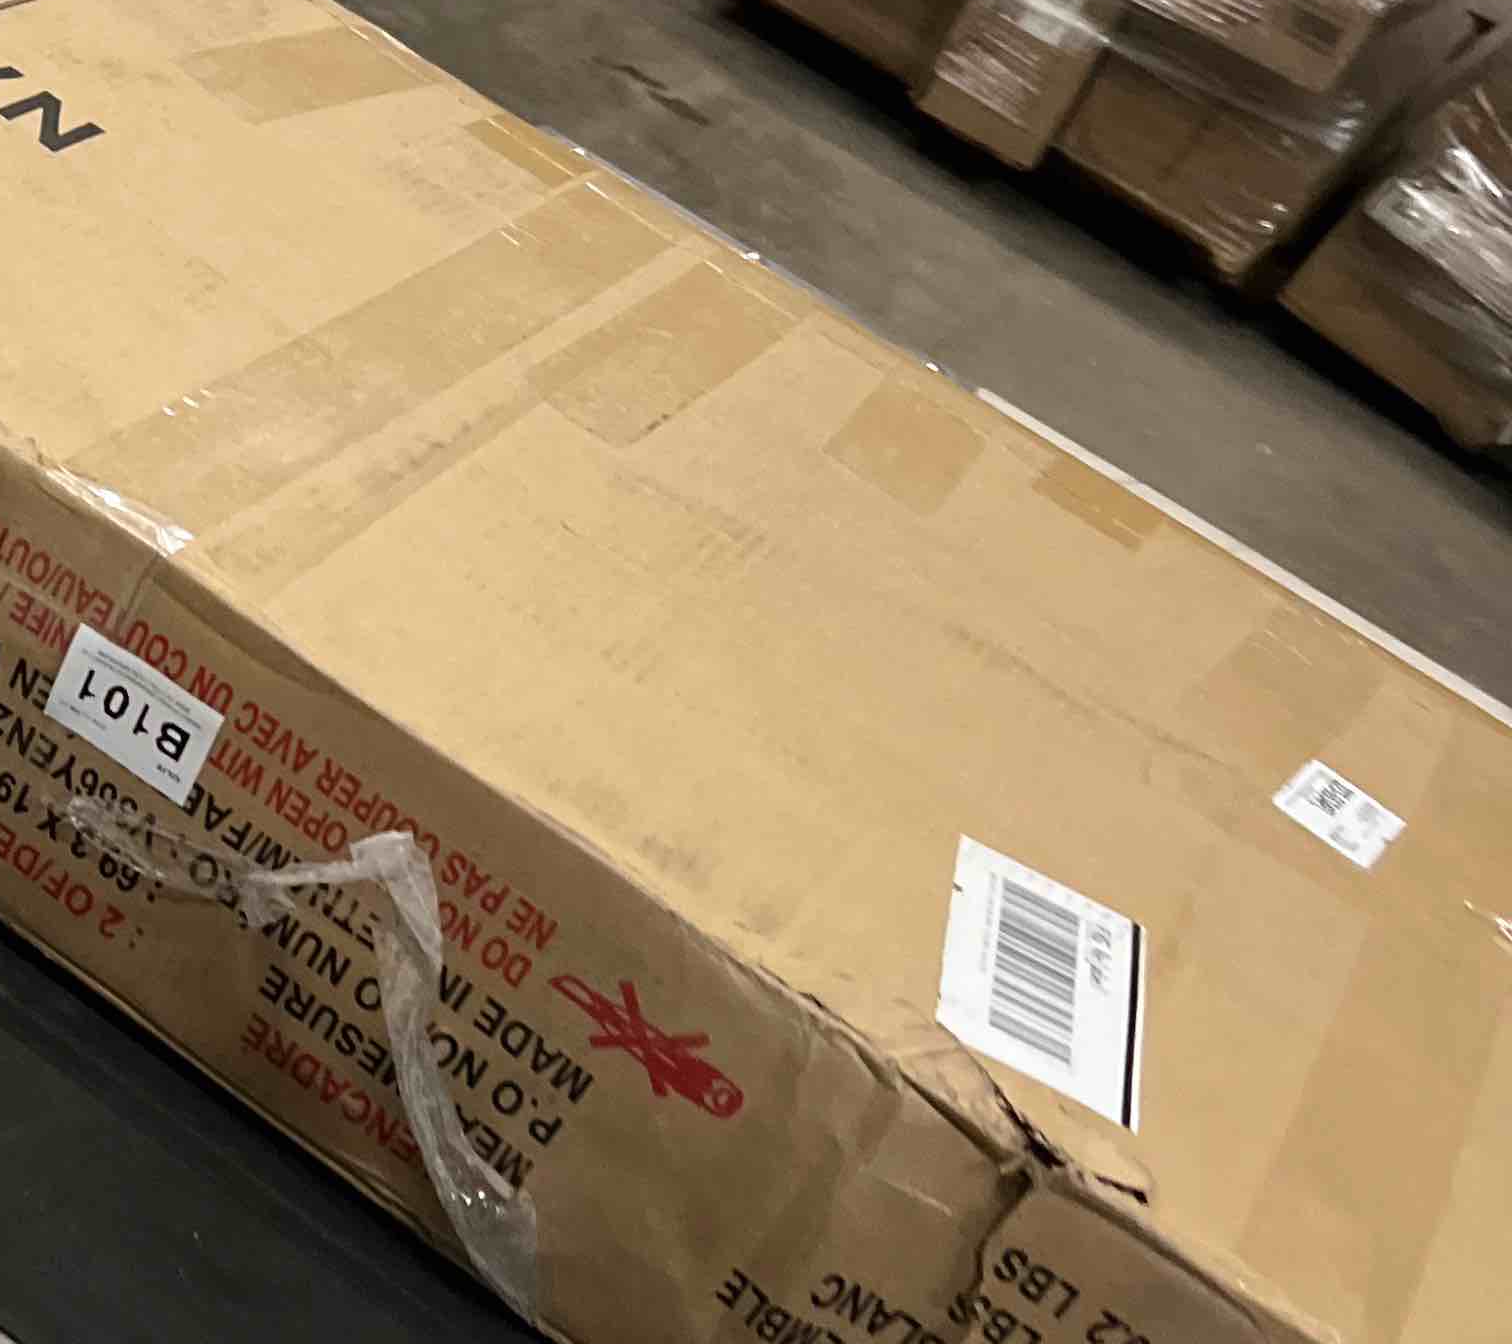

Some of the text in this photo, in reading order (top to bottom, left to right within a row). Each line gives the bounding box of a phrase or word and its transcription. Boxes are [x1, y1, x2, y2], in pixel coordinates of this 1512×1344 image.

[7, 585, 74, 655] NIFE
[8, 655, 54, 710] EN
[188, 660, 234, 718] UN
[78, 669, 191, 763] B101
[232, 695, 318, 773] AVEC
[206, 735, 264, 799] WIT
[34, 799, 66, 843] X
[262, 774, 349, 858] OPEN
[437, 848, 507, 917] PAS
[97, 901, 127, 946] 2
[505, 891, 560, 951] NE
[477, 931, 534, 991] DO
[472, 994, 595, 1103] MADE
[988, 1242, 1081, 1322] LBS
